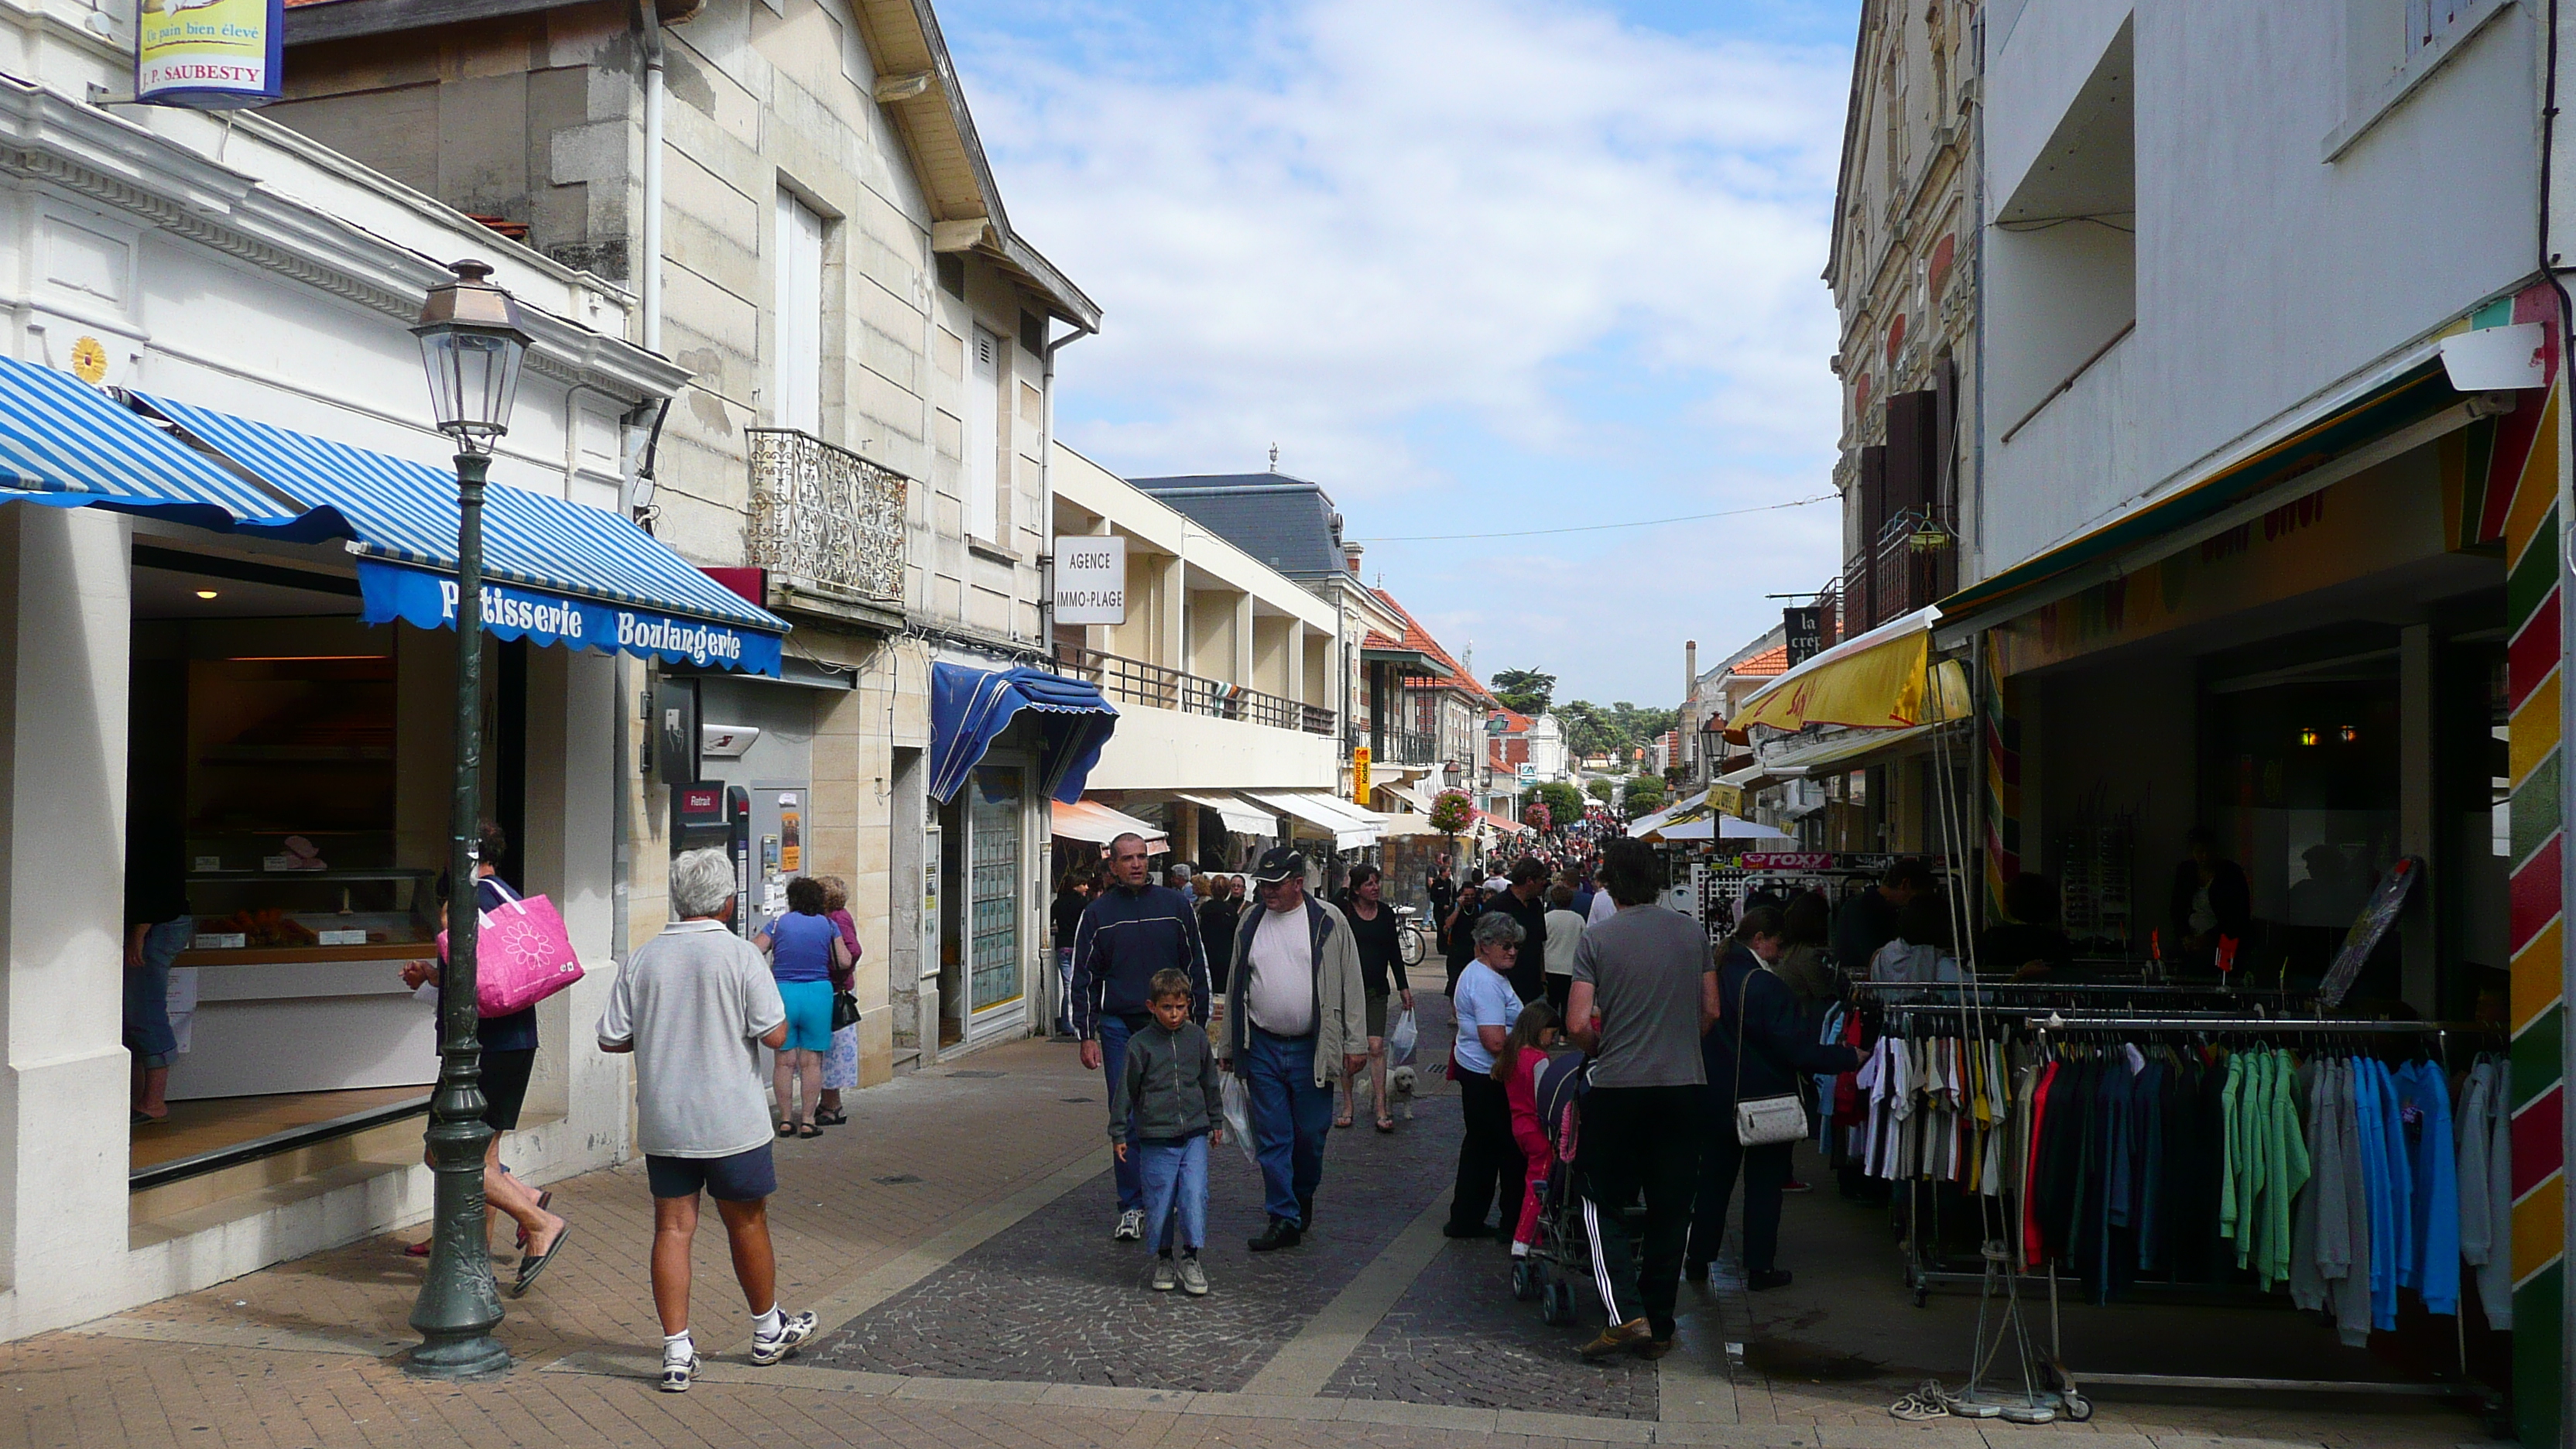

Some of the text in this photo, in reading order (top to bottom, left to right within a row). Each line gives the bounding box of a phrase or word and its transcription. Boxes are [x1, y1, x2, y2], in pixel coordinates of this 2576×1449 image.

[159, 24, 181, 40] pain
[187, 22, 215, 35] bien
[221, 24, 260, 39] élevé
[142, 64, 261, 91] J. P. SAUBESTY
[1069, 553, 1110, 569] AGENCE
[1057, 591, 1122, 607] IMMO-PLAGE
[439, 579, 742, 665] Ptisserie Boulangerie
[1800, 613, 1816, 629] la
[690, 795, 711, 806] Retrait
